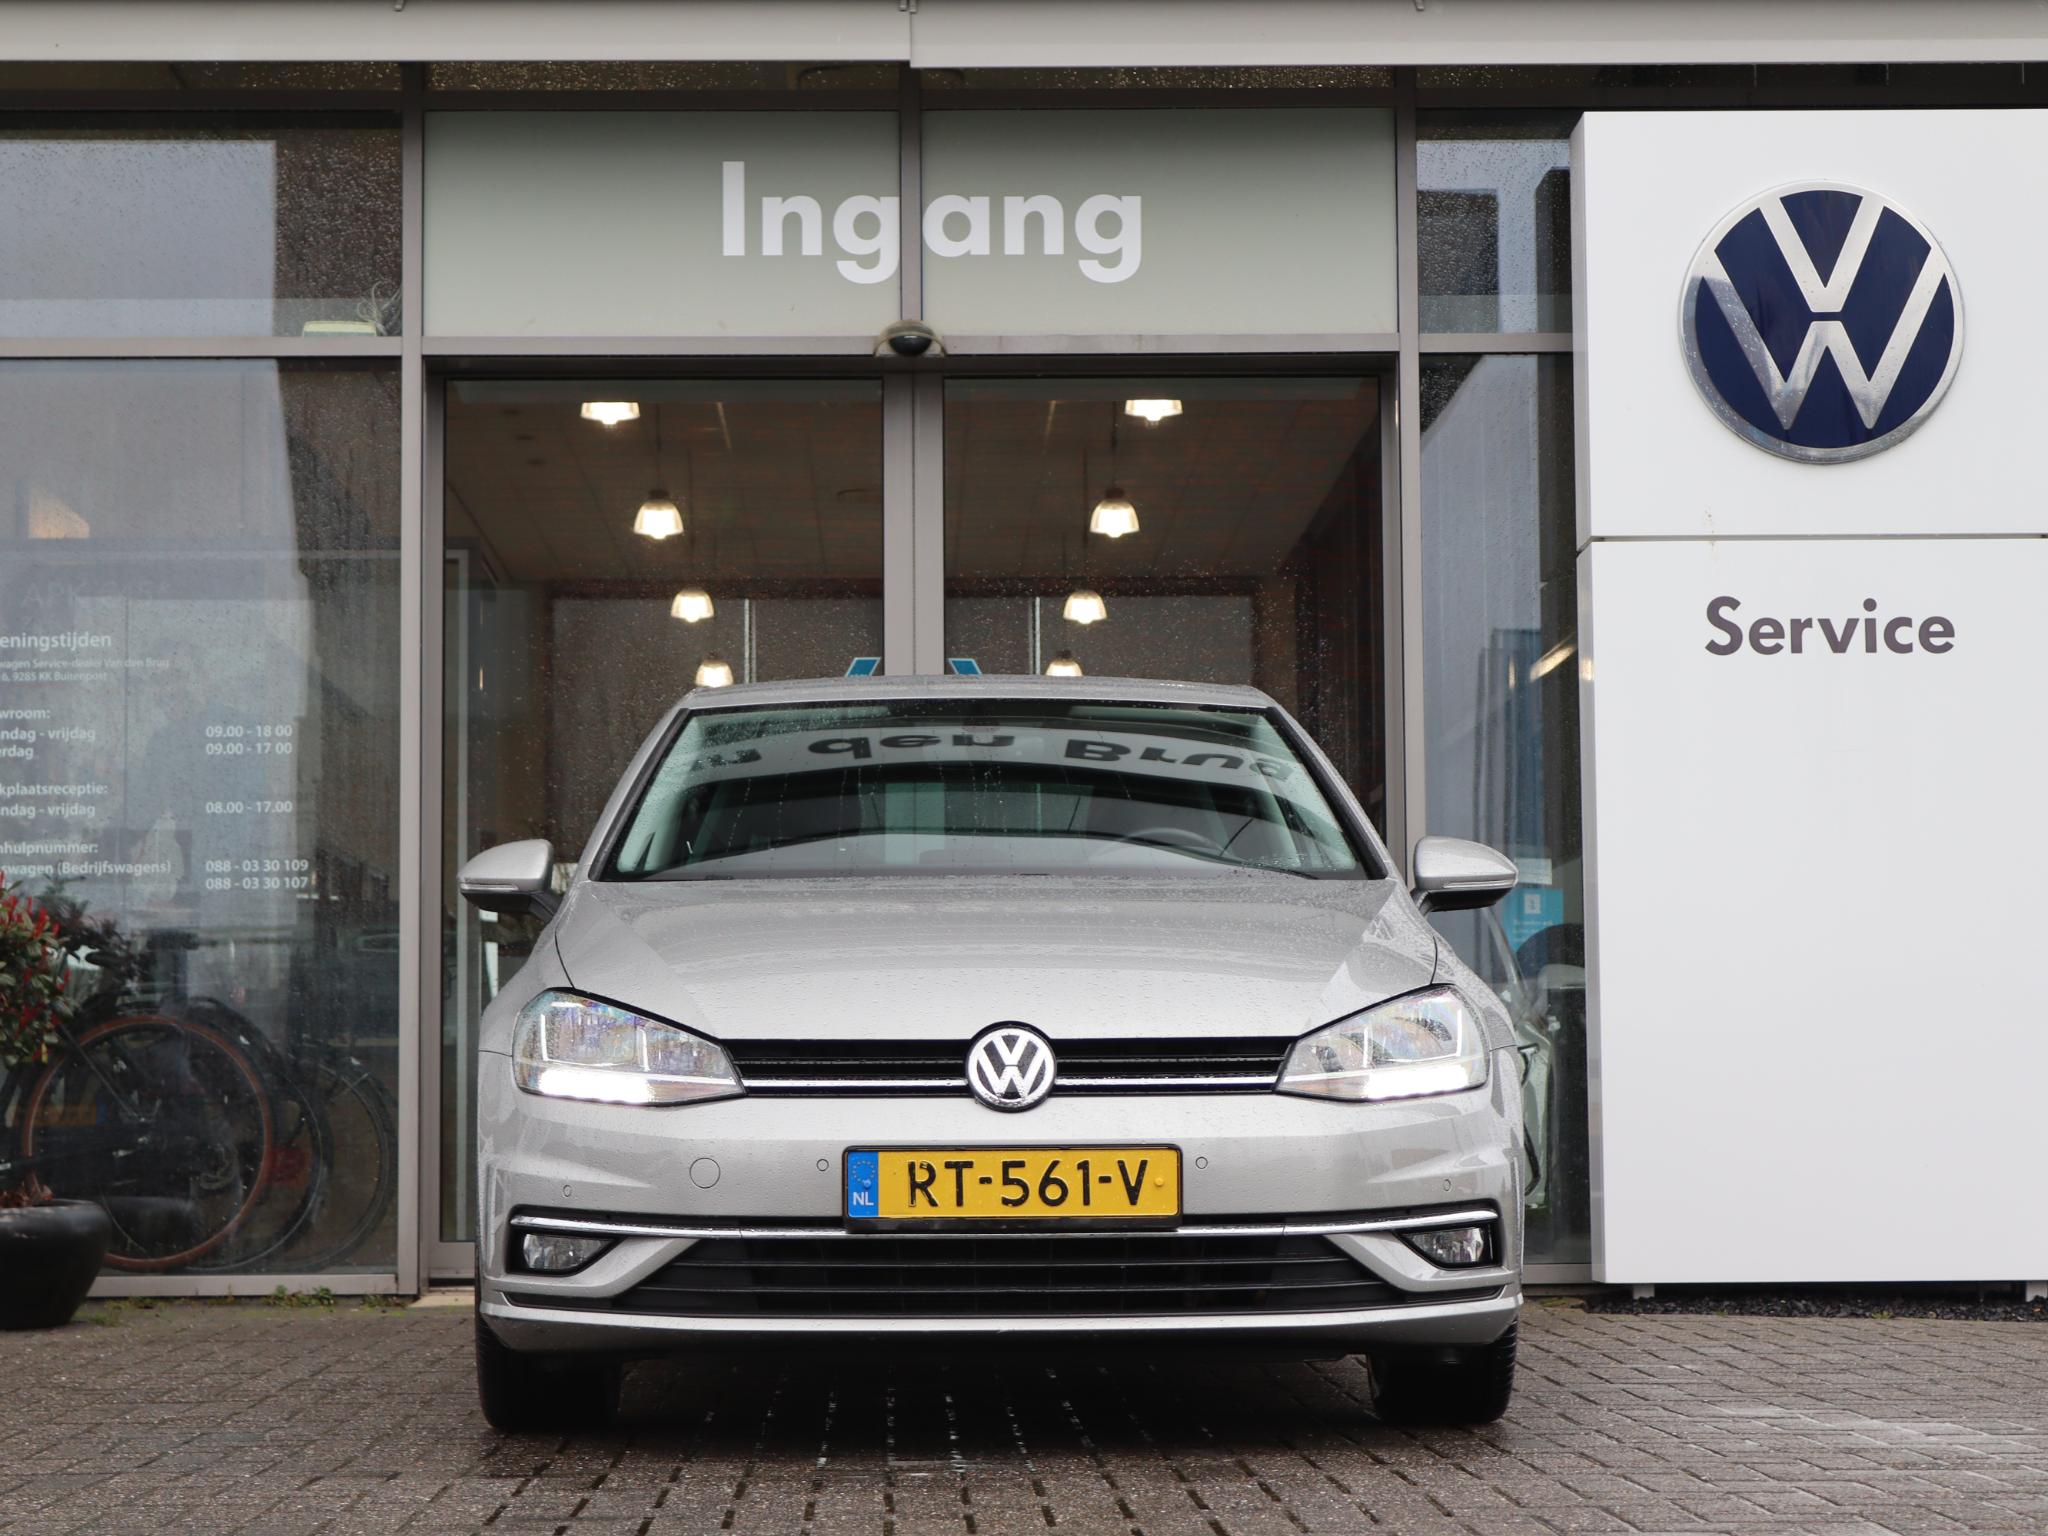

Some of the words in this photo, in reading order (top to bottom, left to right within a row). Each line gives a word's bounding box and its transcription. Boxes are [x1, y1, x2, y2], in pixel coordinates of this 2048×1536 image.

[722, 161, 1142, 284] Ingang
[1688, 185, 1960, 450] VW
[1704, 596, 1956, 657] Service
[48, 727, 96, 742] vrijdag
[206, 725, 244, 738] 09.00
[0, 744, 34, 760] rdag
[206, 742, 244, 755] 09.00
[48, 803, 96, 818] vrijdag
[206, 801, 244, 814] 08.00
[256, 801, 293, 814] 17.00
[57, 860, 172, 877] (Bedrijfswagens)
[206, 860, 231, 873] 088
[243, 860, 260, 872] 03
[263, 860, 280, 872] 30
[285, 859, 309, 872] 109
[206, 877, 231, 890] 088
[243, 878, 260, 890] 03
[263, 877, 280, 890] 30
[285, 877, 309, 889] 107
[907, 1158, 1149, 1208] RT-561-V
[852, 1191, 875, 1207] NL
